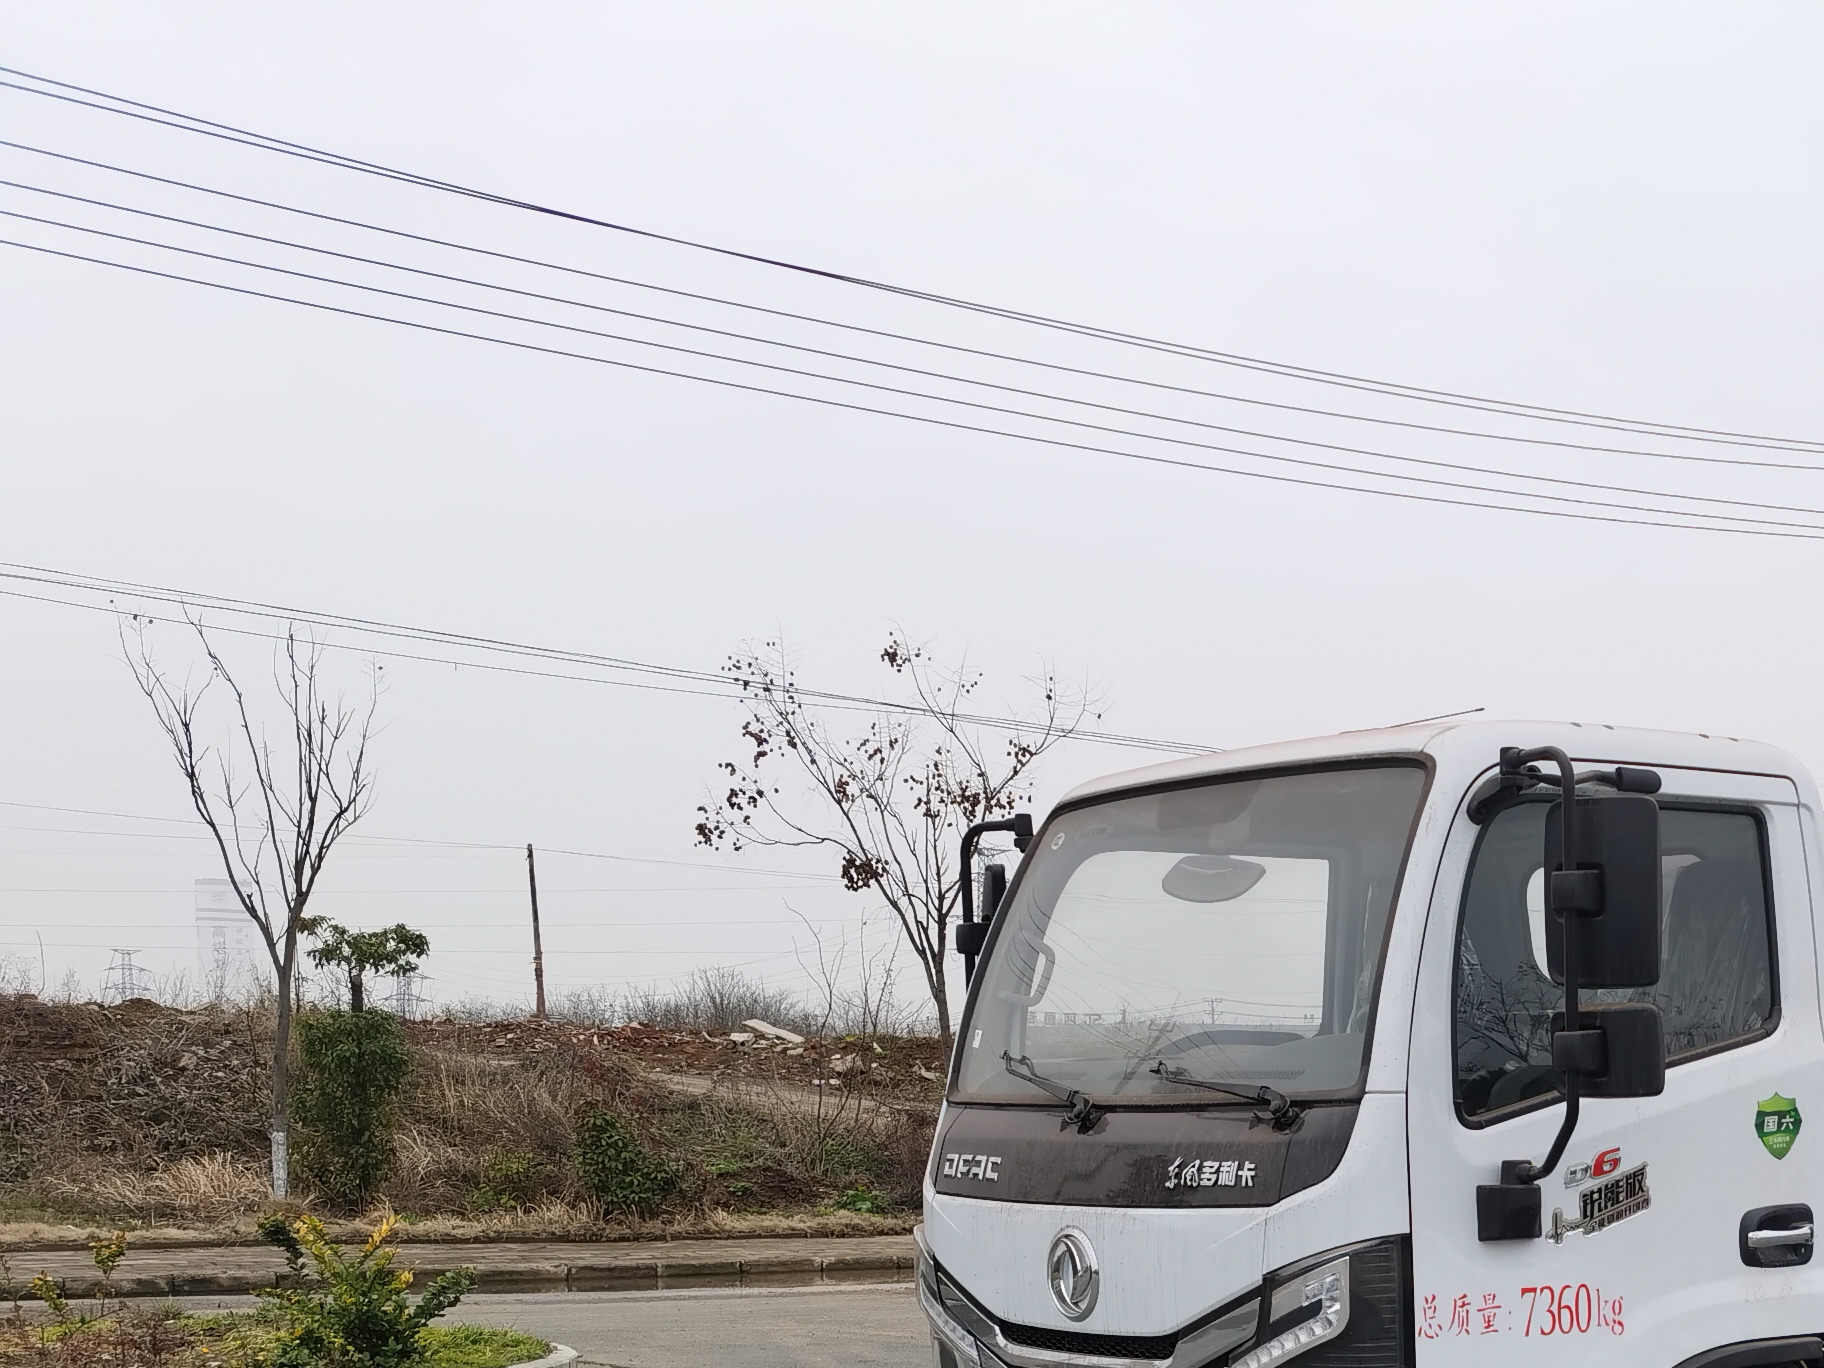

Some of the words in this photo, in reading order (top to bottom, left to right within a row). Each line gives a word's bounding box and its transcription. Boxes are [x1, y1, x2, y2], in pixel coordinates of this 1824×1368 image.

[1763, 1114, 1795, 1133] 国六
[943, 1153, 1002, 1182] DFAC
[1165, 1156, 1256, 1189] 东风多利卡
